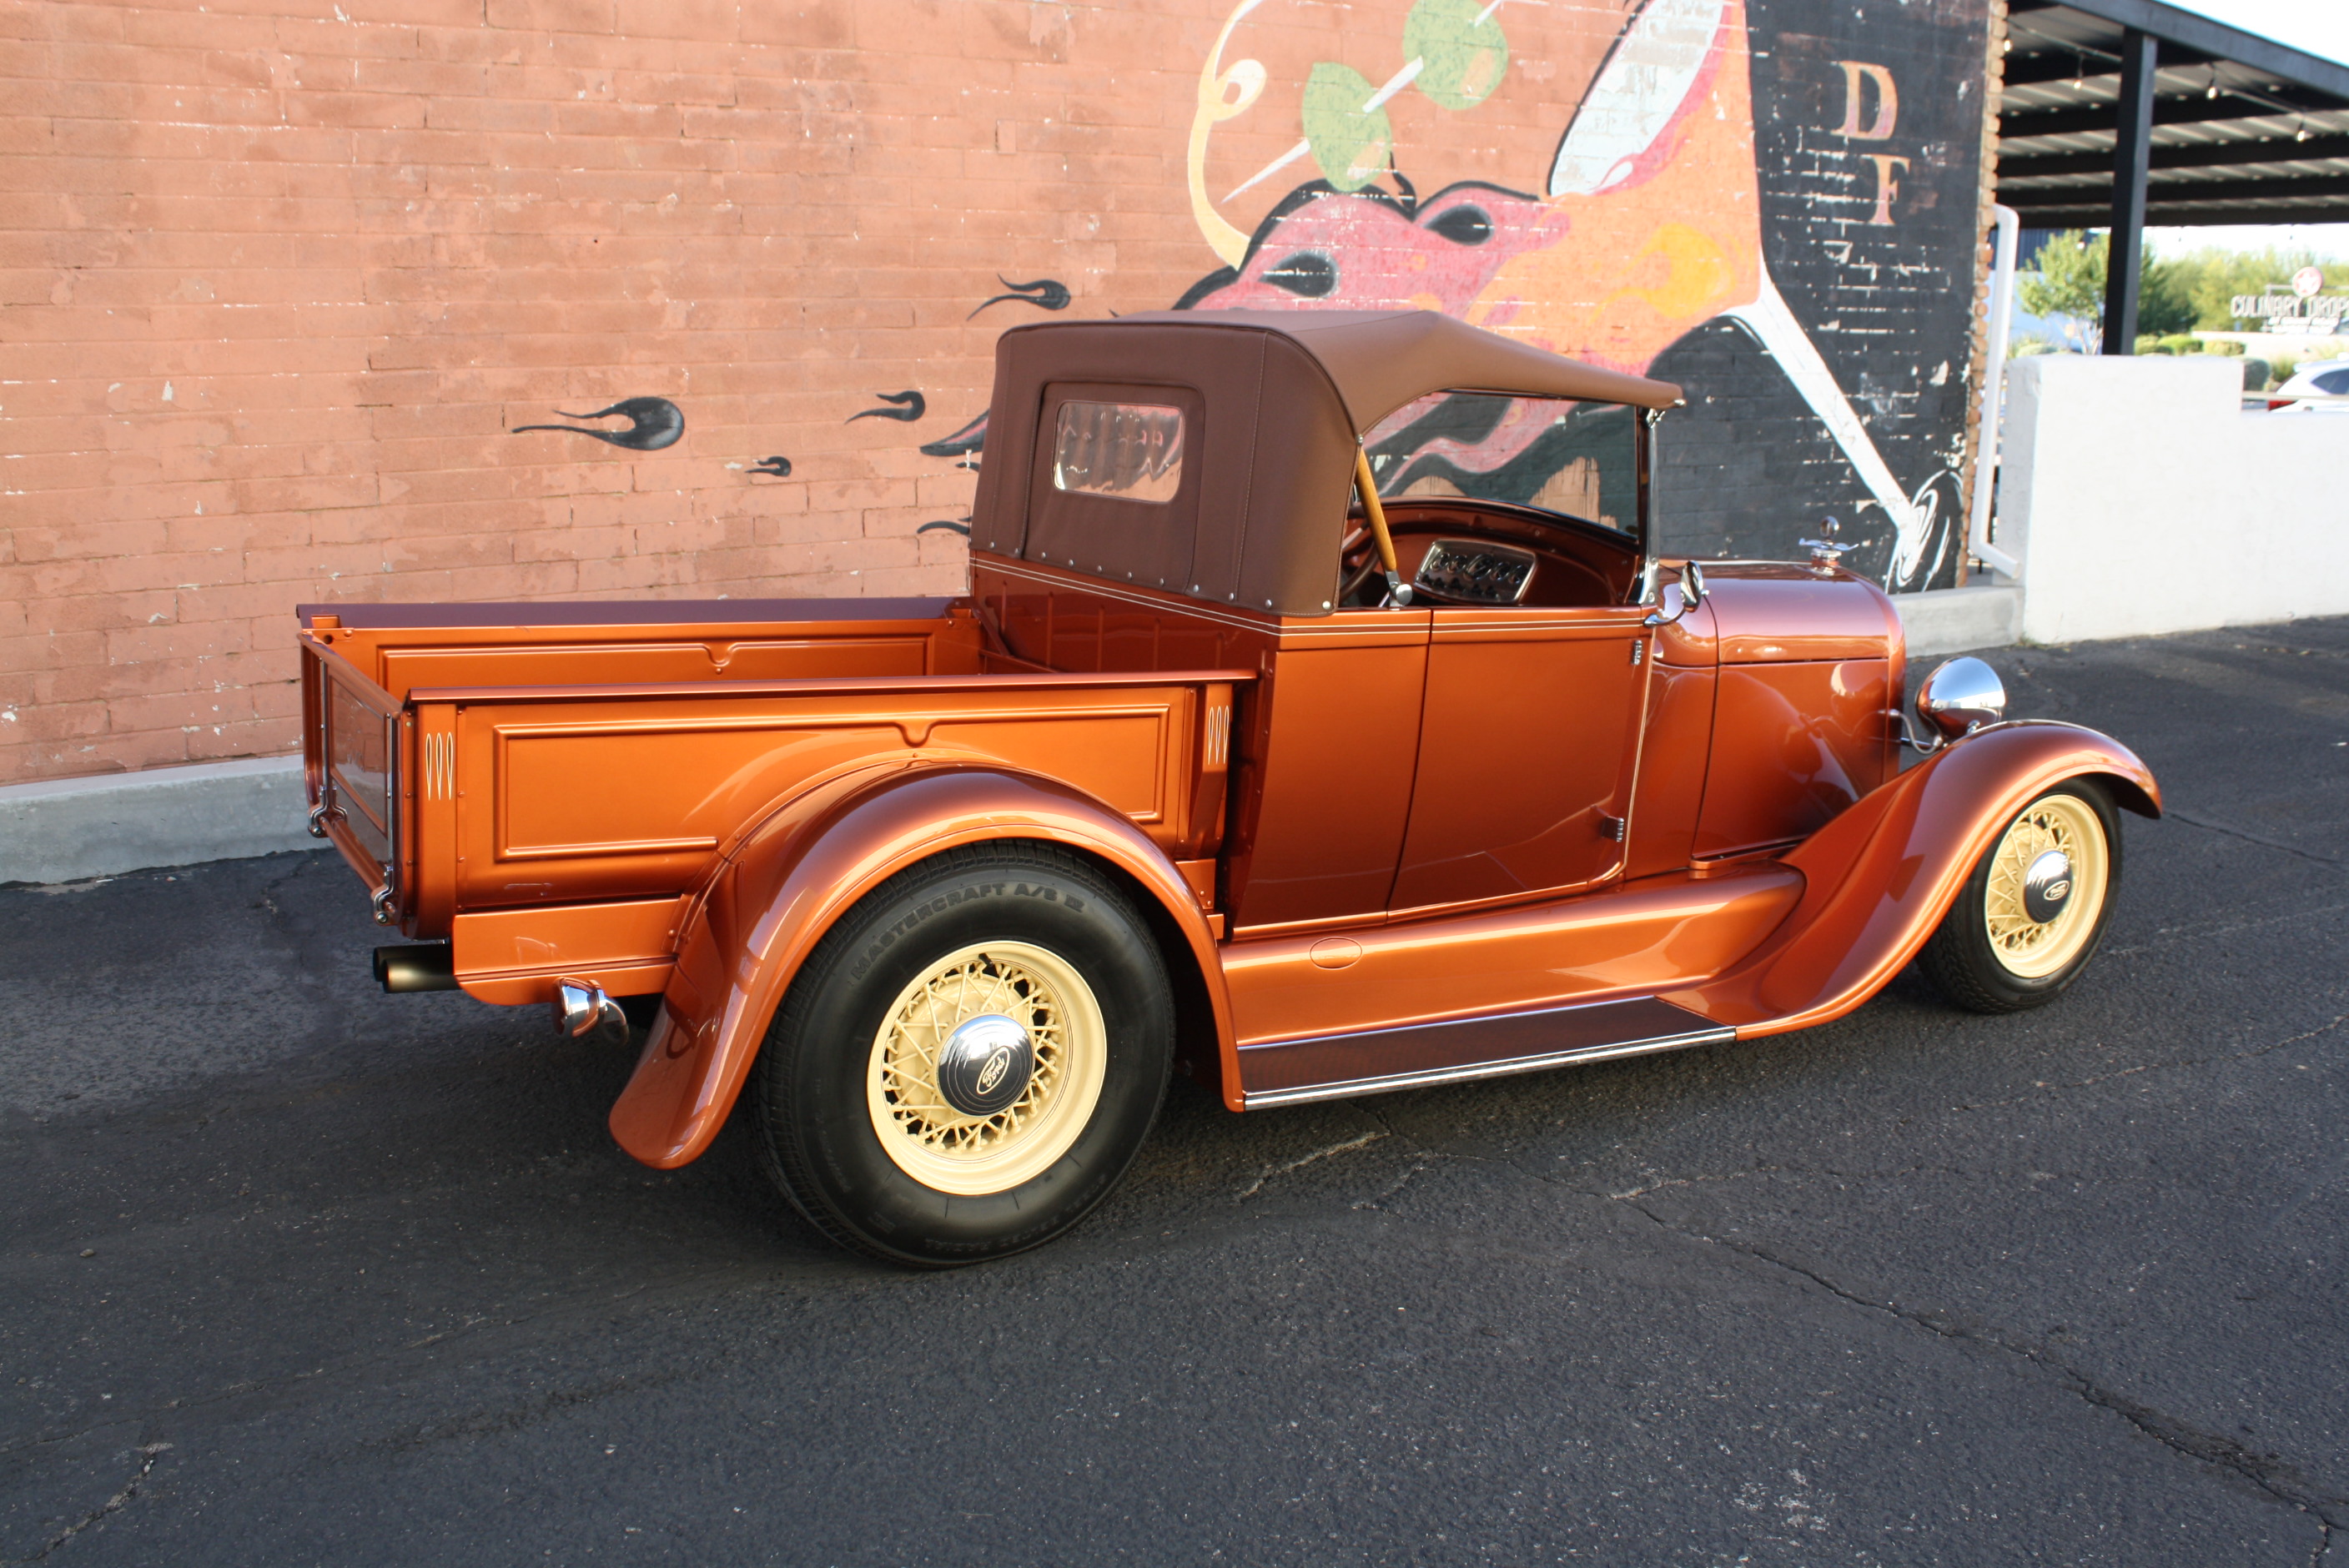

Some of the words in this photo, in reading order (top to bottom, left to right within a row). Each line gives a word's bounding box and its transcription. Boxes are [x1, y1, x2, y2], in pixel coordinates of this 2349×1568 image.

[1829, 60, 1899, 141] D
[1867, 153, 1911, 226] F
[2231, 294, 2303, 318] CULINARY
[851, 882, 1005, 981] MASTERCRAFT
[1014, 882, 1058, 902] A/S
[982, 1056, 1005, 1088] Ford
